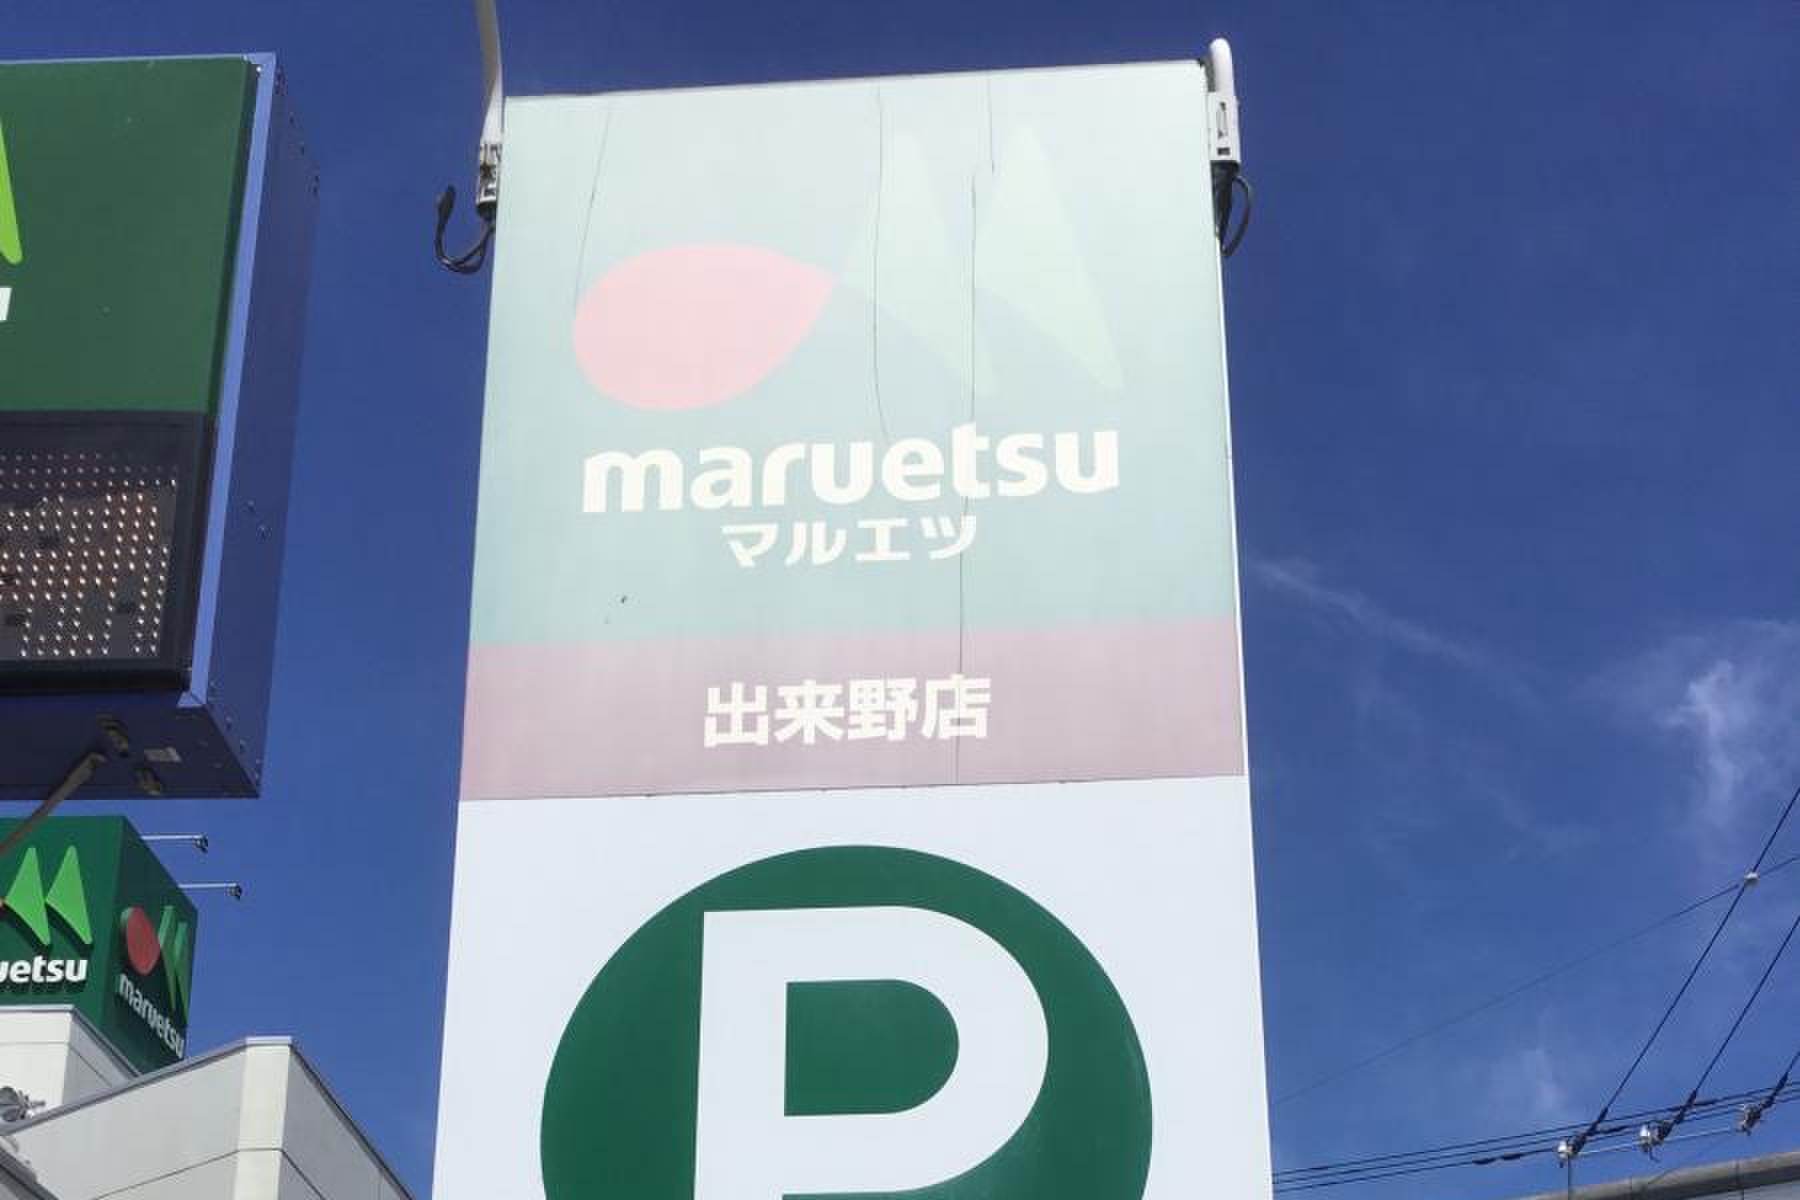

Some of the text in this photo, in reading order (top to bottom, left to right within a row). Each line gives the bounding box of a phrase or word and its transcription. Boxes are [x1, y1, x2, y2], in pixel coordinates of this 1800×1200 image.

[582, 421, 1119, 513] maruetsu
[721, 515, 977, 568] マルエツ
[703, 673, 992, 748] 出来野店
[118, 973, 185, 1059] maruetsu
